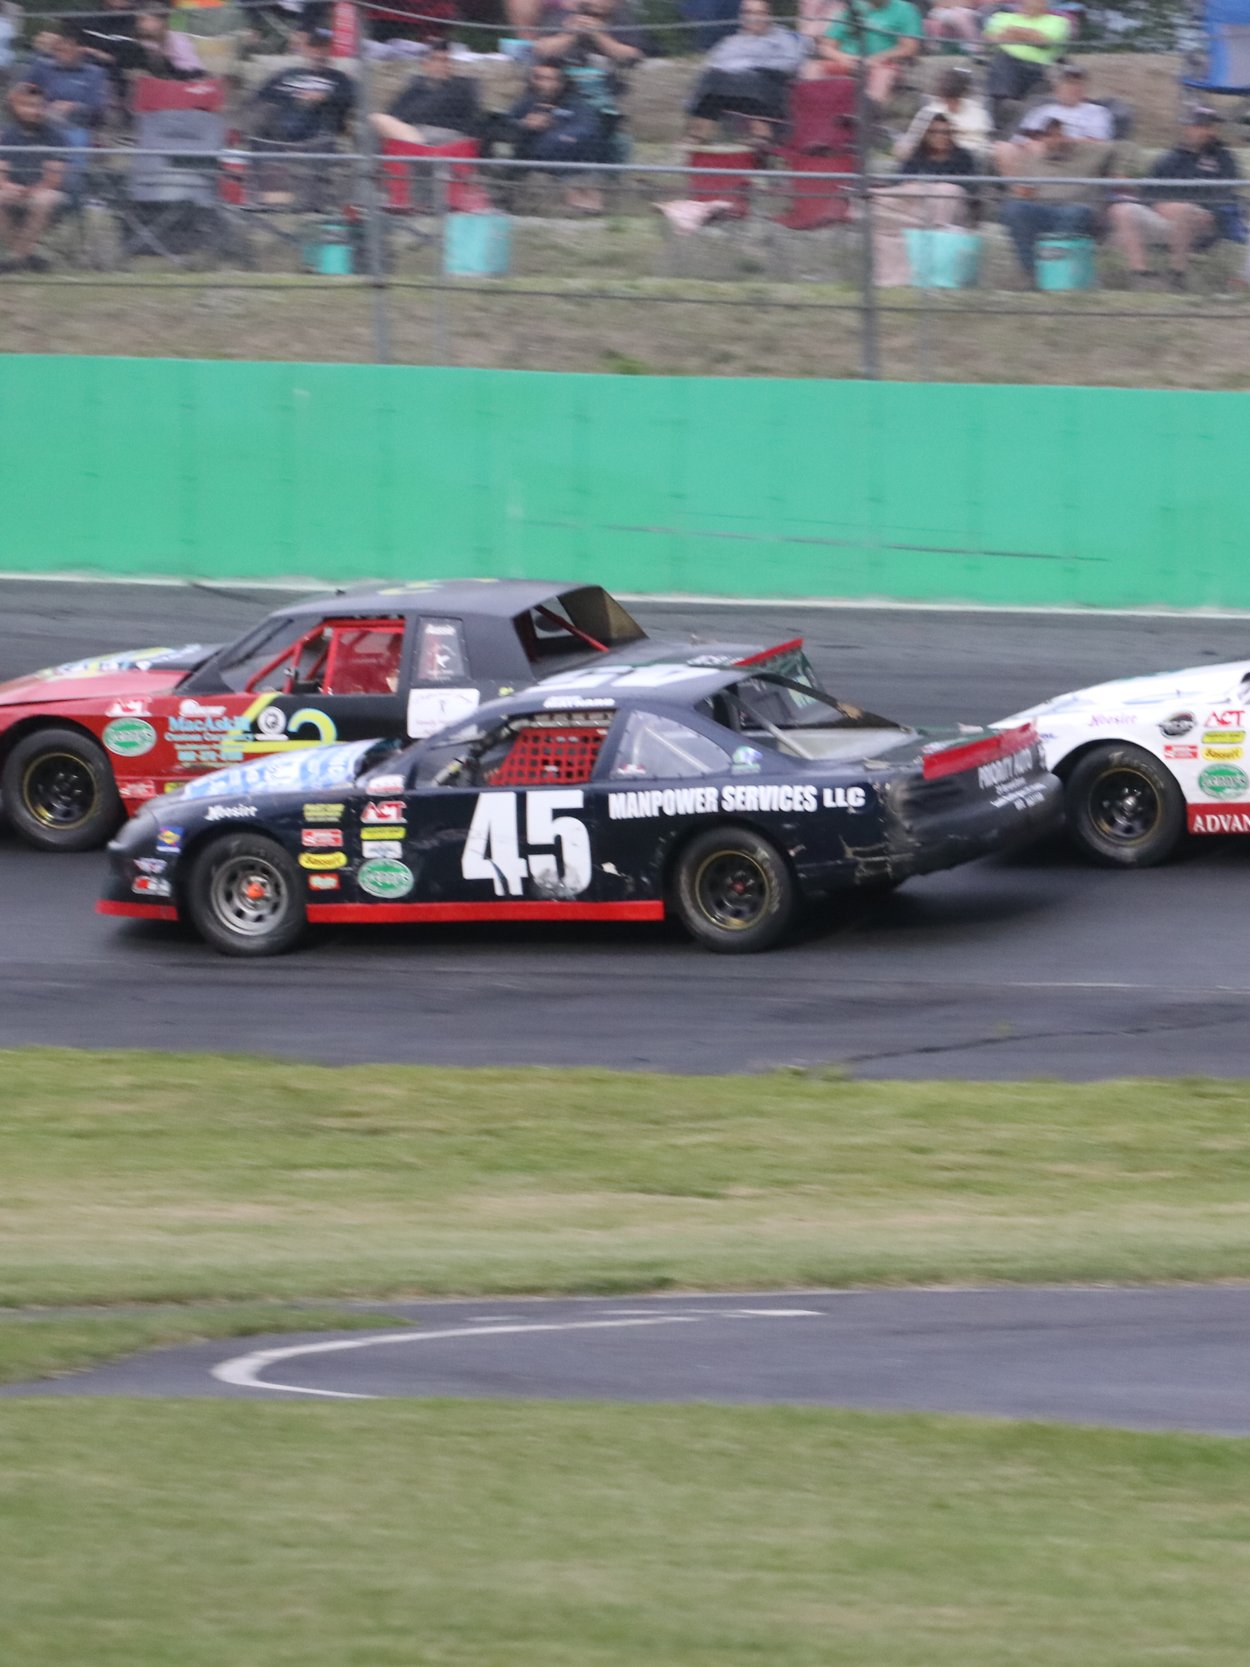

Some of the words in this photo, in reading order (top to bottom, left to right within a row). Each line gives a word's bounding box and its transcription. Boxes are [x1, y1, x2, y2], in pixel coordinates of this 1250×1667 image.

[1204, 710, 1246, 728] ACT
[608, 786, 719, 820] MANPOWER
[721, 785, 818, 812] SERVICES
[823, 787, 866, 808] LLC
[461, 790, 592, 899] 45
